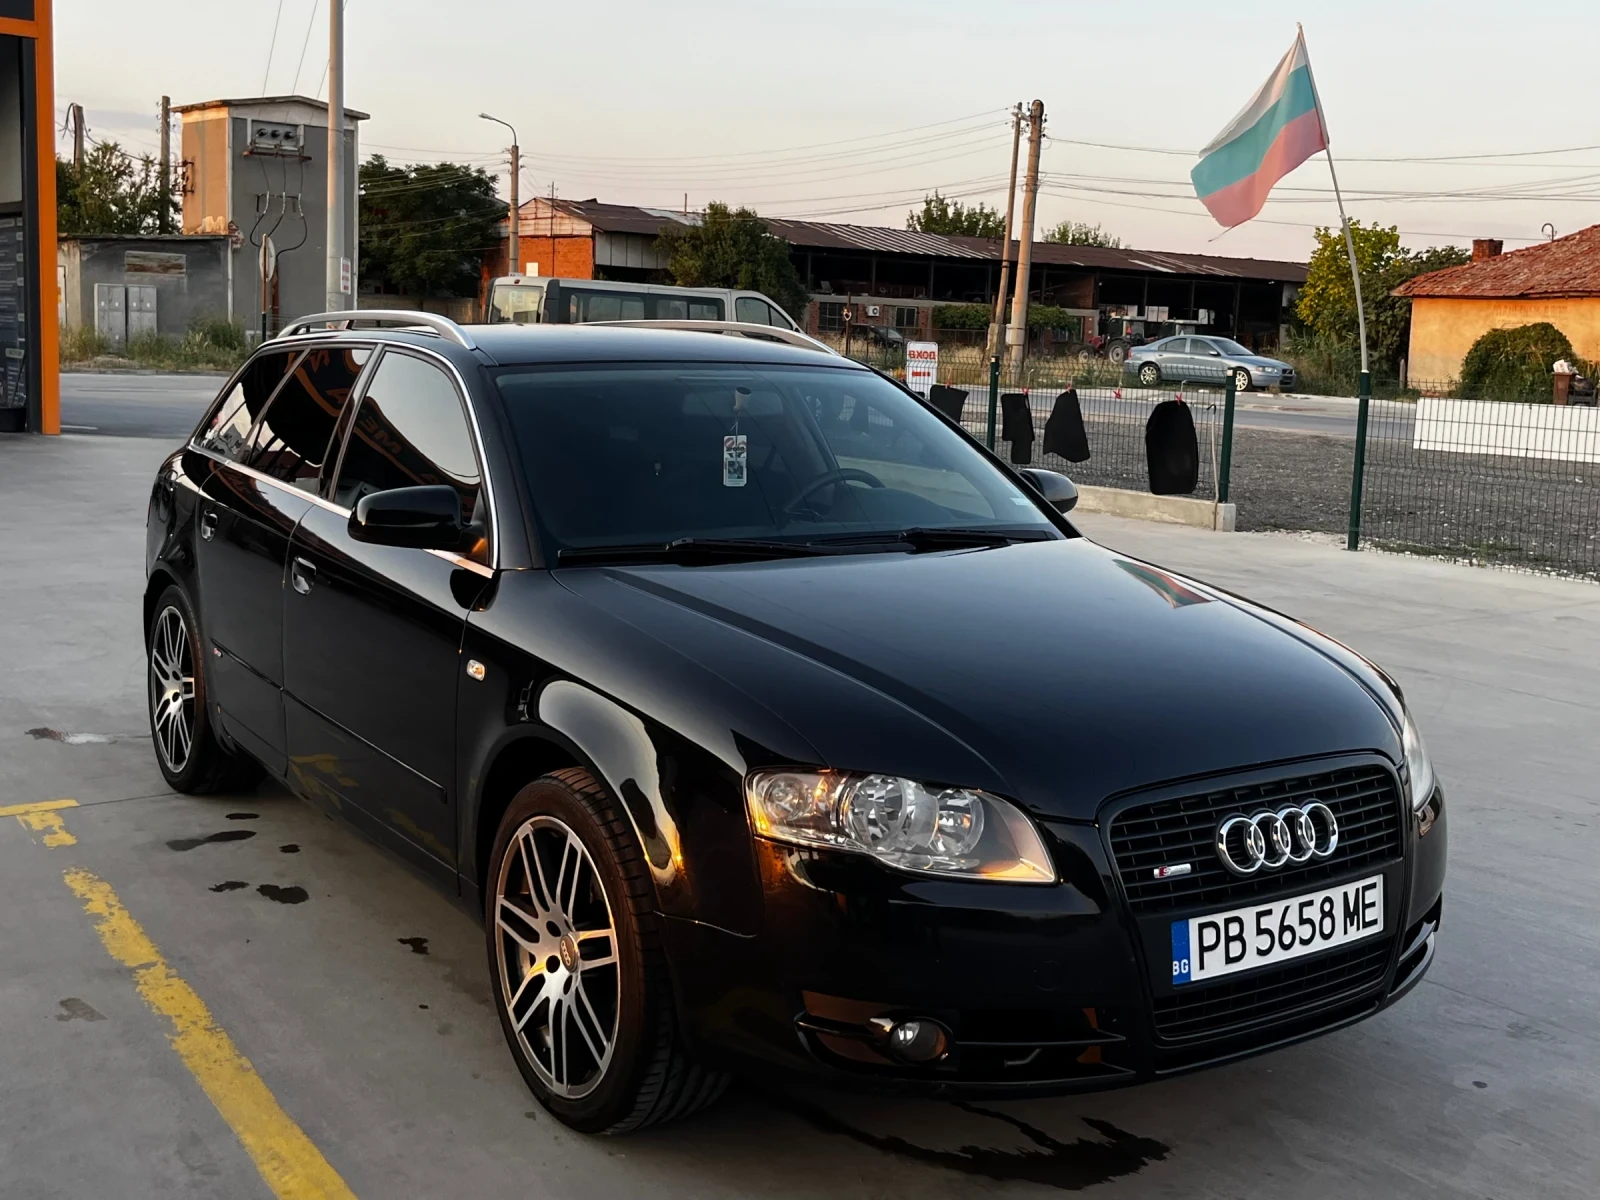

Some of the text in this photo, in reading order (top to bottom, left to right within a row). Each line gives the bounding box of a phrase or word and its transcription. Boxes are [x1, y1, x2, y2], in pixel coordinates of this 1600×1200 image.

[908, 350, 936, 360] ВХОД
[1197, 882, 1379, 971] PB 5658 ME
[1172, 960, 1189, 976] BG
